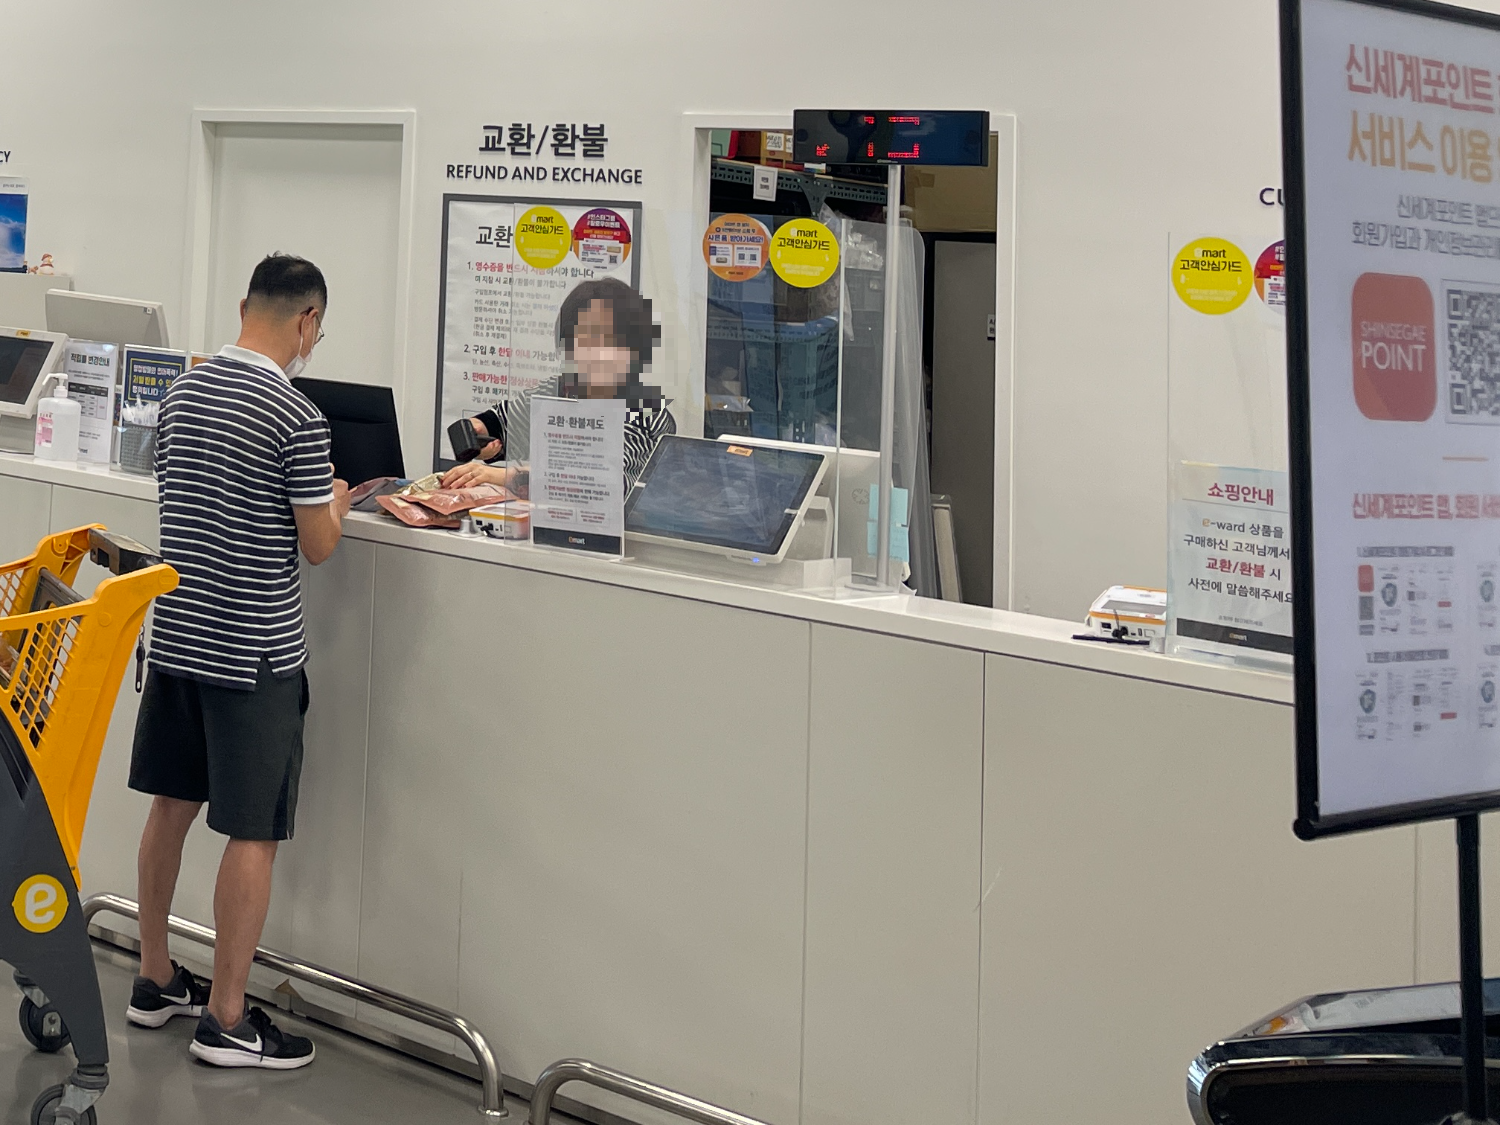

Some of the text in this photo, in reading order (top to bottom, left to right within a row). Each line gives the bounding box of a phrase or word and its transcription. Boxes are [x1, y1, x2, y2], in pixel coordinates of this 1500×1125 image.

[1346, 43, 1495, 114] 신세계포인트
[478, 123, 608, 158] 교환/환불
[1348, 110, 1493, 183] 서비스 이용
[446, 164, 643, 185] REFUND AND EXCHANGE
[520, 223, 564, 235] 고객안심가드
[777, 237, 830, 251] 고객안심가드
[475, 261, 504, 272] 영수증을
[571, 267, 594, 278] 합니다
[1180, 259, 1242, 272] 고객안심가드
[1361, 321, 1427, 342] SHINSEGAE
[472, 345, 487, 355] 구입
[1361, 341, 1427, 373] POINT
[1207, 482, 1274, 506] 쇼핑안내
[1248, 524, 1284, 539] 상품을
[1183, 534, 1290, 560] 구매하신 고객님께서
[1205, 557, 1281, 581] 교환/환불 시
[1187, 578, 1293, 603] 사전에 말씀해주세요
[25, 882, 57, 924] e
